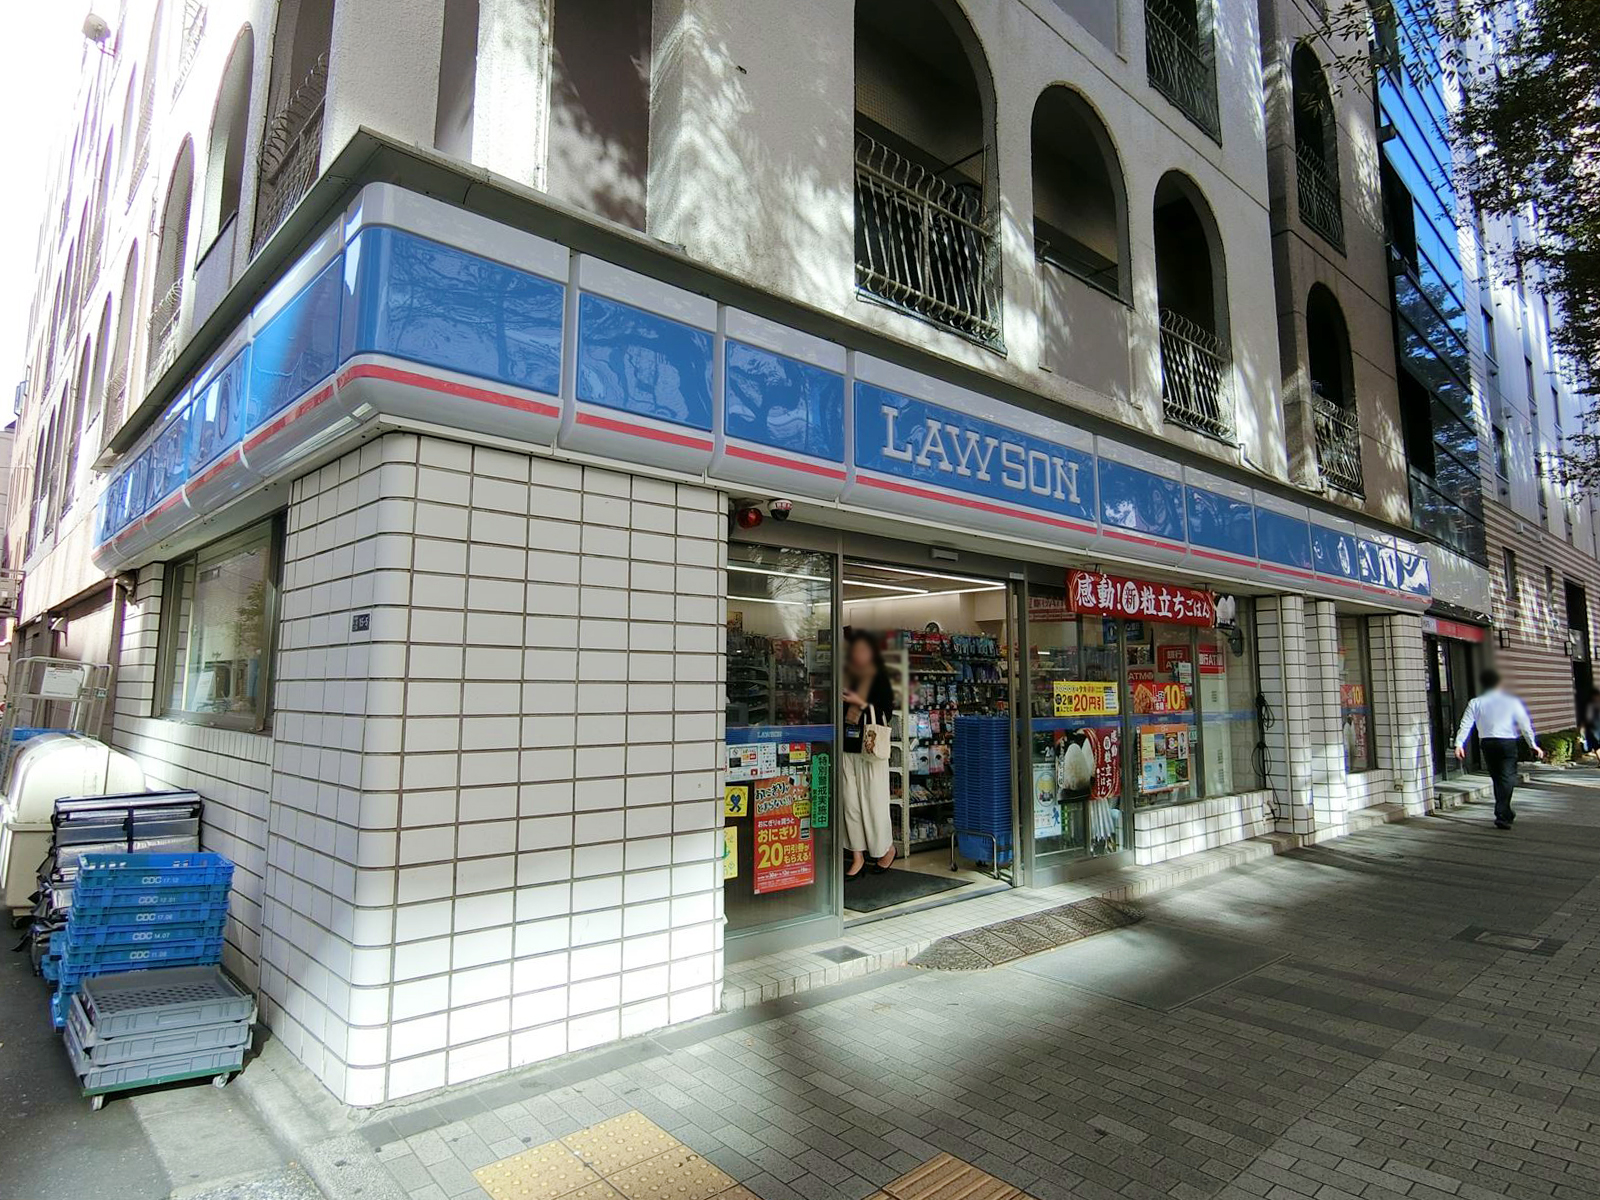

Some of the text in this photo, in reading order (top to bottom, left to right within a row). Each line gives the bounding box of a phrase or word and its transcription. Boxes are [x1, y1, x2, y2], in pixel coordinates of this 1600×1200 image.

[880, 405, 1081, 504] LAWSON
[1073, 694, 1105, 712] 20円引
[1164, 685, 1181, 710] 10
[757, 825, 798, 843] おにぎり
[757, 842, 784, 869] 20
[142, 876, 162, 885] CDC
[138, 896, 159, 904] CDC
[135, 913, 156, 922] CDC
[132, 932, 153, 940] CDC
[129, 951, 150, 960] CDC
